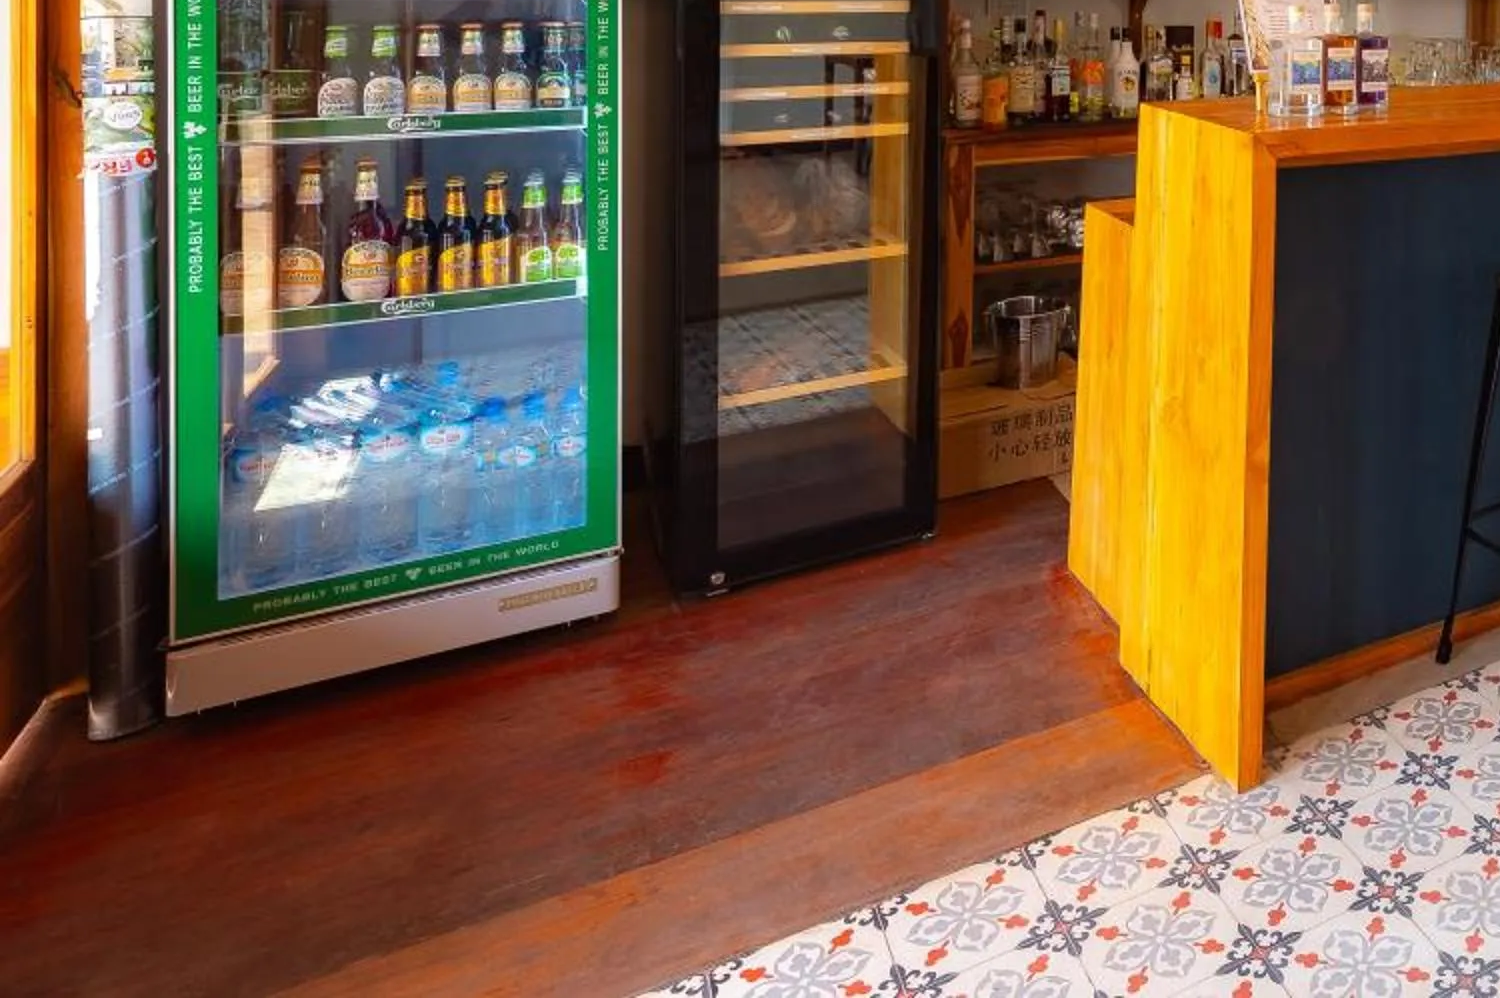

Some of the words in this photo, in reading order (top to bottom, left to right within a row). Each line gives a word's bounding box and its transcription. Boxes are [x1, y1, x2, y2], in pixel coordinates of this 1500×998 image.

[188, 22, 202, 50] THE
[597, 17, 608, 40] THE
[188, 55, 202, 69] IN
[597, 63, 608, 95] BEER
[188, 75, 202, 113] BEER
[387, 116, 441, 133] Carlsberg
[597, 123, 608, 154] BEST
[188, 146, 202, 181] BEST
[597, 159, 608, 182] THE
[188, 187, 202, 214] THE
[597, 187, 608, 251] PROBABLY
[188, 219, 202, 293] PROBABLY
[381, 298, 435, 315] Carlsberg
[253, 589, 326, 613] PROBABLY
[333, 581, 357, 595] THE
[364, 573, 397, 590] BEST
[428, 560, 463, 575] BEER
[488, 549, 510, 562] THE
[516, 540, 559, 556] WORLD
